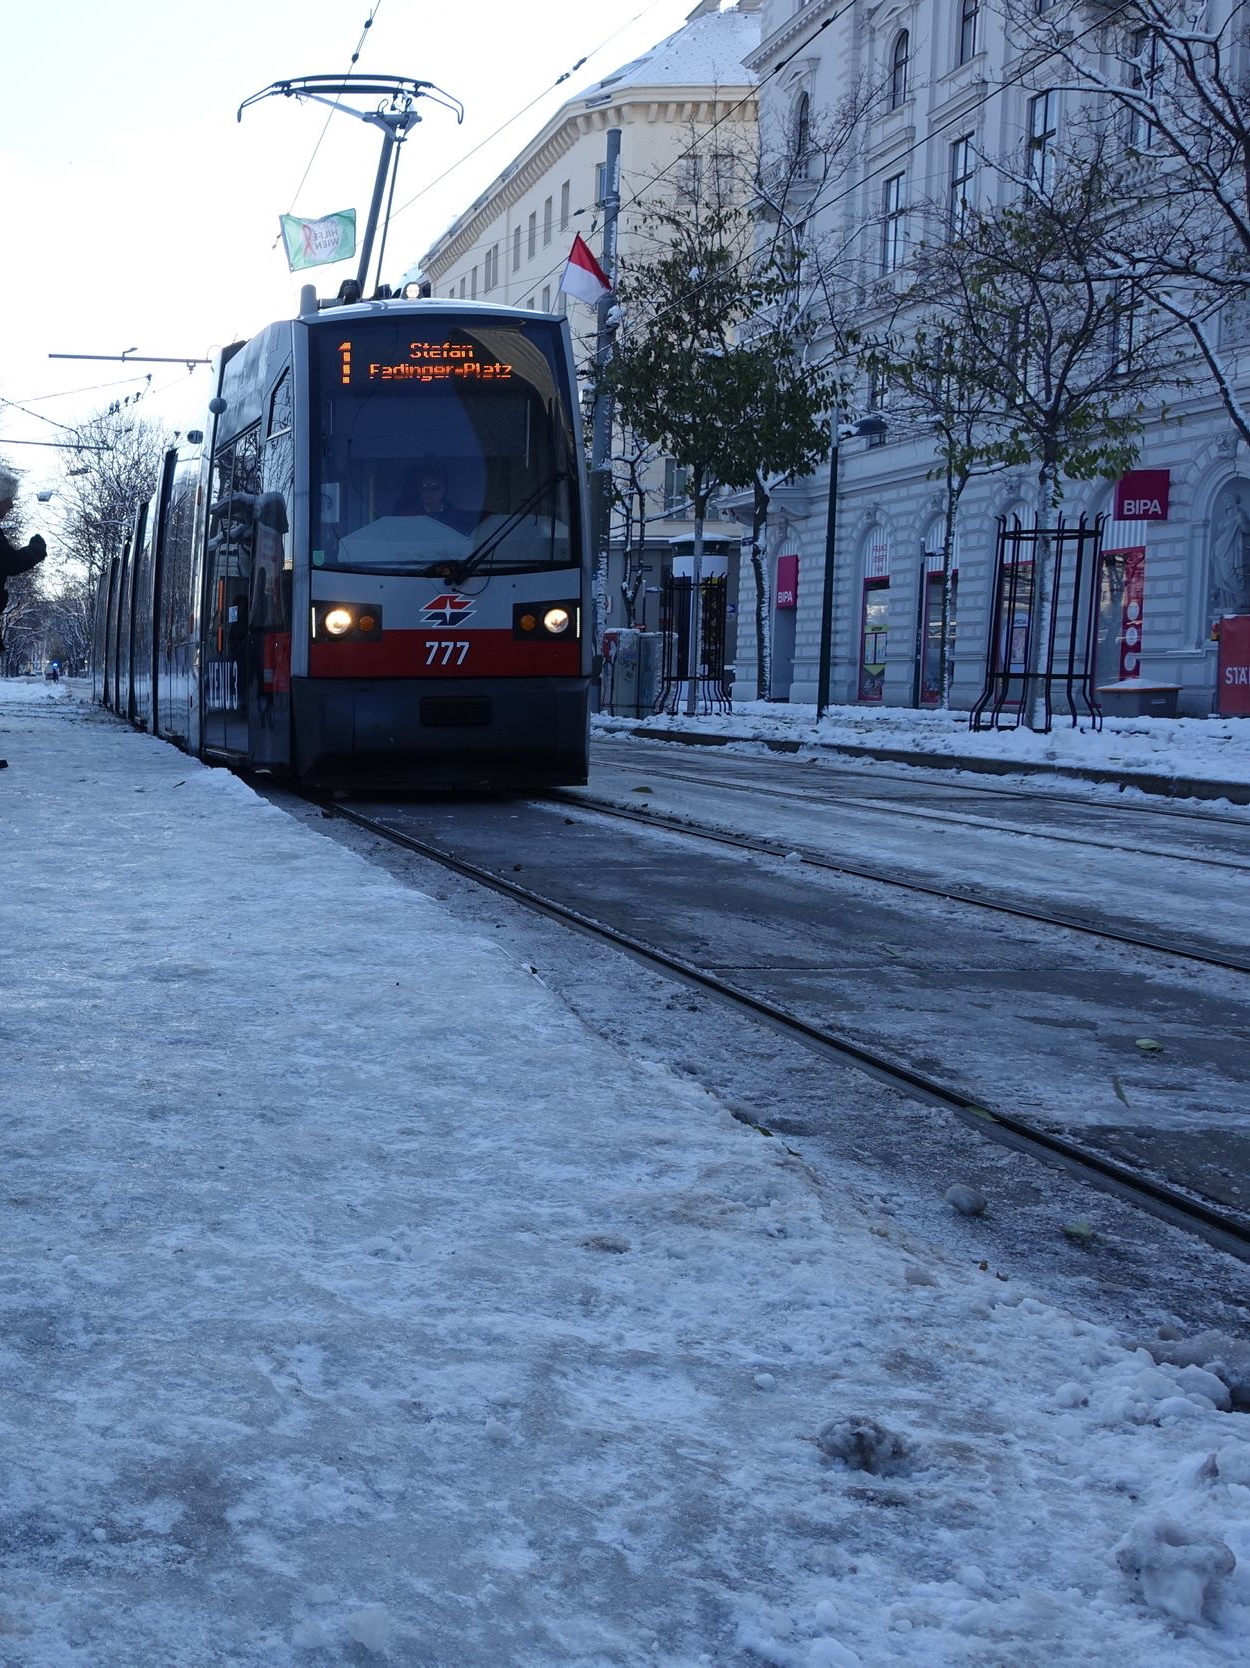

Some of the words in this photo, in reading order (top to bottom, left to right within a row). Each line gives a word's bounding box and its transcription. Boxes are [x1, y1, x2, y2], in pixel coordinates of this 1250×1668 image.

[409, 342, 474, 358] Stefan
[338, 342, 351, 384] 1
[369, 362, 512, 382] Fadinger-Platz
[1123, 499, 1162, 516] BIPA
[778, 591, 793, 604] BIPA
[425, 641, 470, 665] 777
[1225, 667, 1250, 685] STÄ
